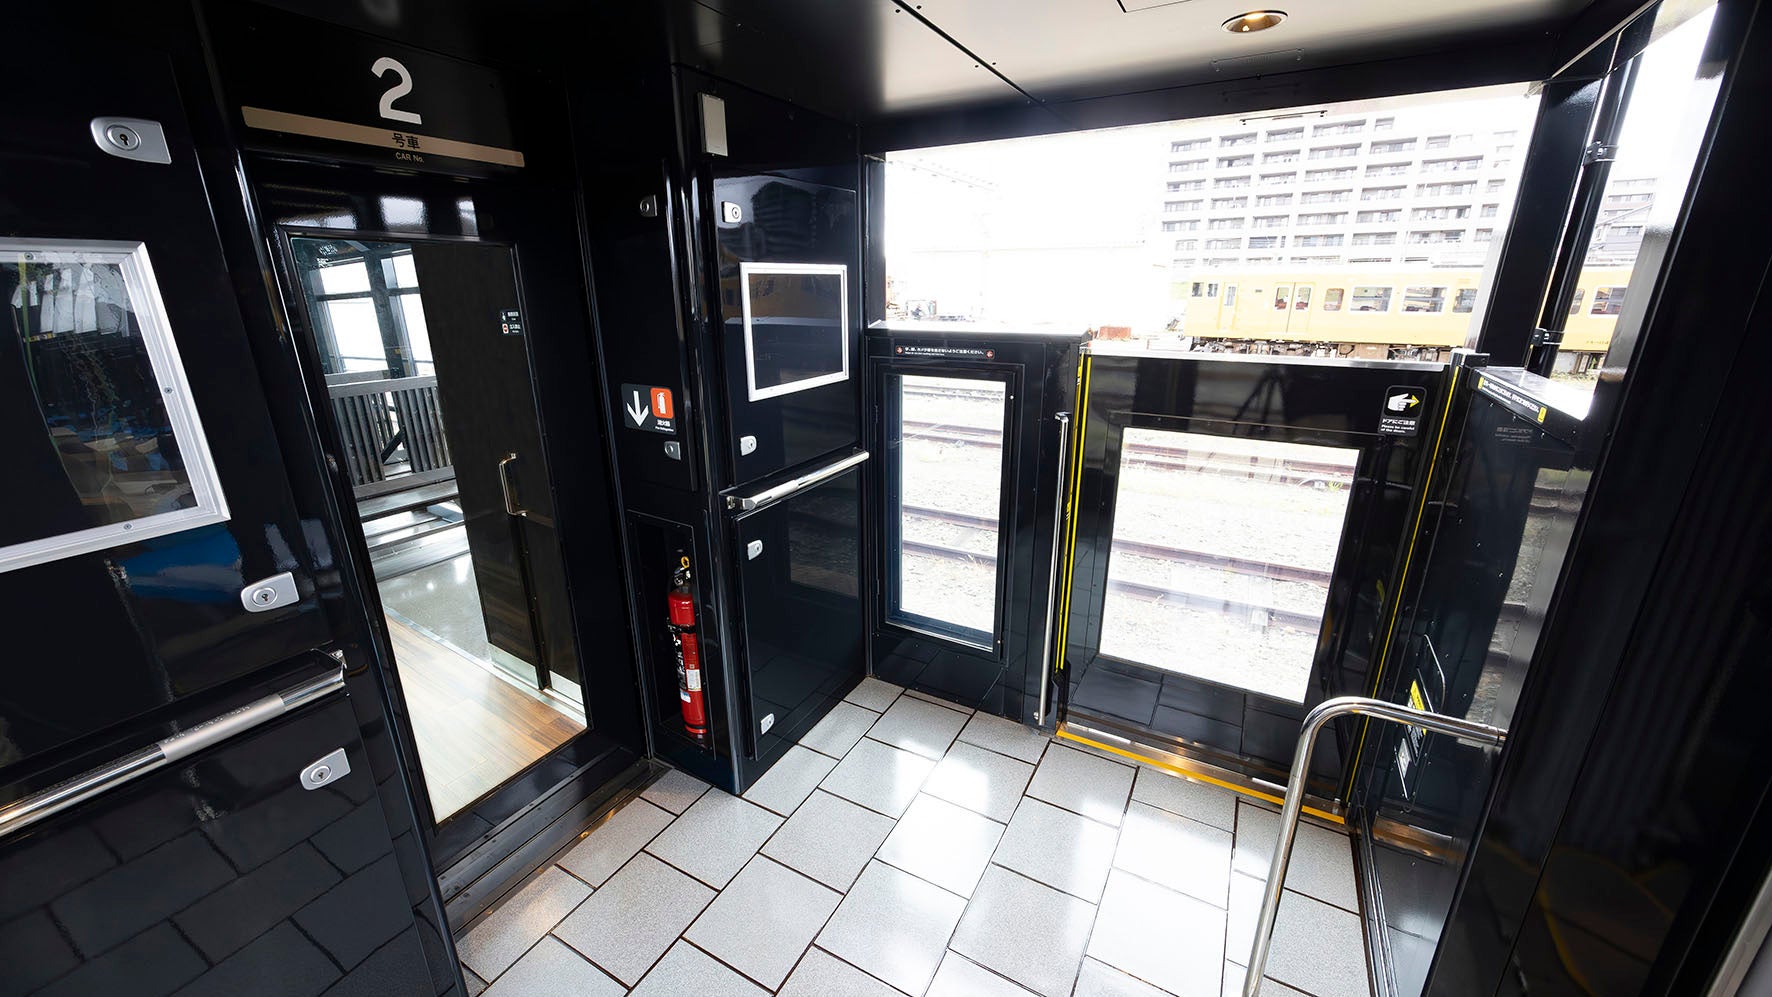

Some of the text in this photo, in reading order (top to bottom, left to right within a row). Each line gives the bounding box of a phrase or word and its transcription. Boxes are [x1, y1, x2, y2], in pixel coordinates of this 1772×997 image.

[371, 57, 422, 125] 2
[392, 132, 421, 149] 号車
[395, 152, 424, 163] CAR No.
